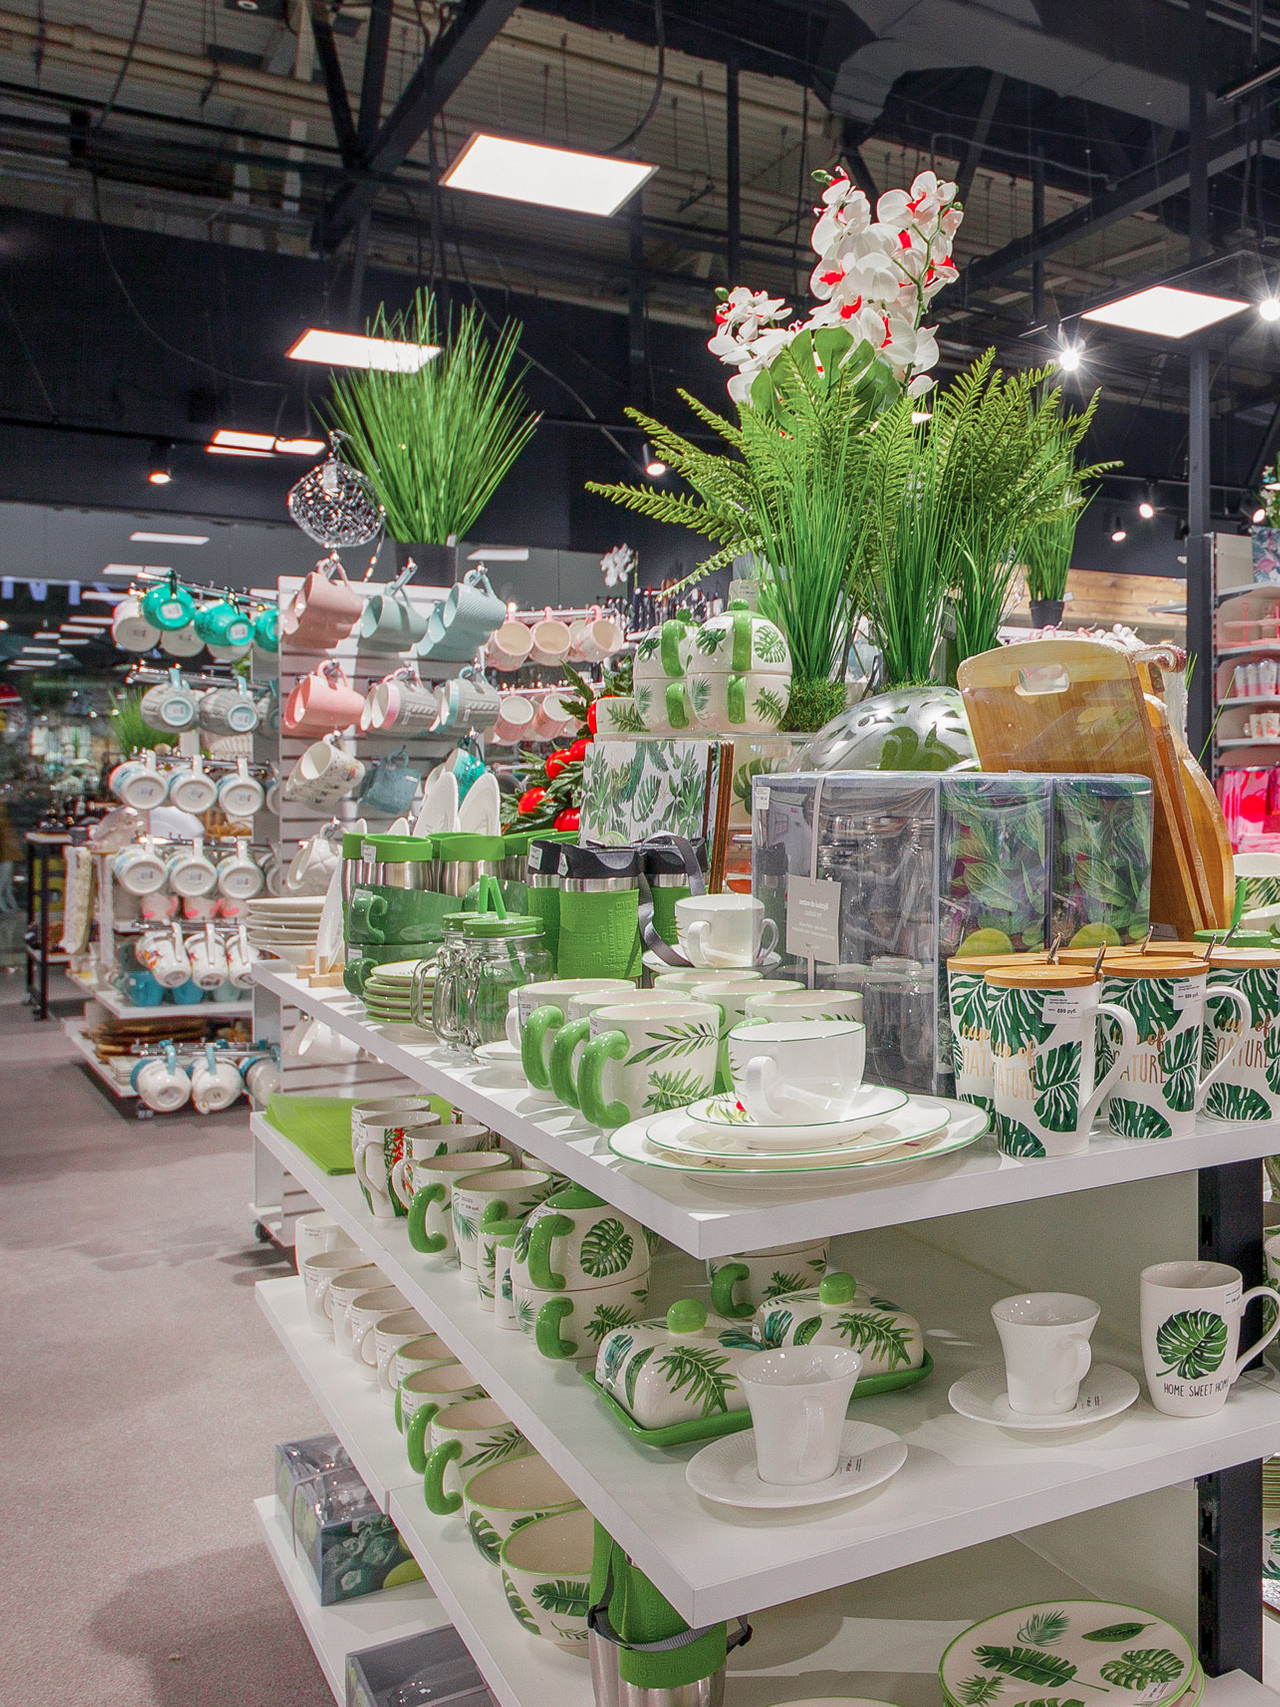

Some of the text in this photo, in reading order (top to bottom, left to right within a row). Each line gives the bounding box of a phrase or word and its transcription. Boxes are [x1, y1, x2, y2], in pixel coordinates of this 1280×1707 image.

[1147, 1026, 1168, 1053] of
[1017, 1040, 1040, 1068] of
[1163, 1382, 1185, 1398] HOME
[1188, 1383, 1214, 1398] SWEET
